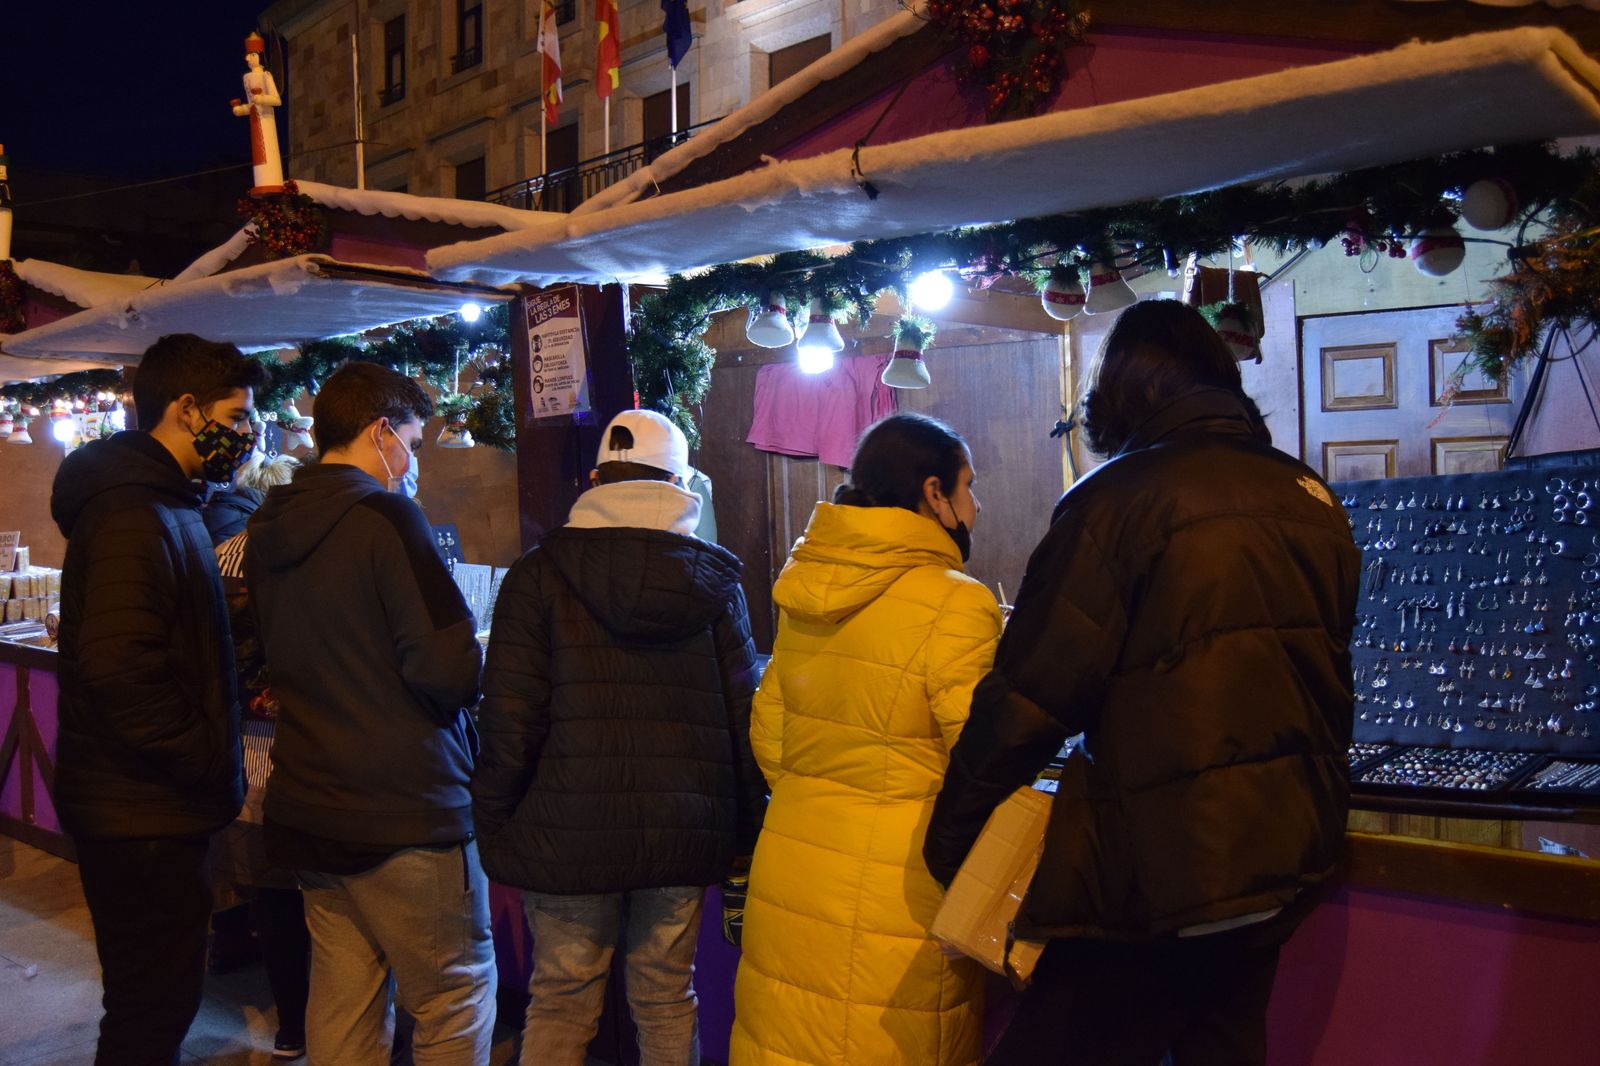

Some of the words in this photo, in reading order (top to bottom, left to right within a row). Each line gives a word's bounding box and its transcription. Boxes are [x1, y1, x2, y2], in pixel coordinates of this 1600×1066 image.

[535, 310, 548, 324] LAS
[548, 307, 553, 318] 3
[552, 298, 571, 315] EMES
